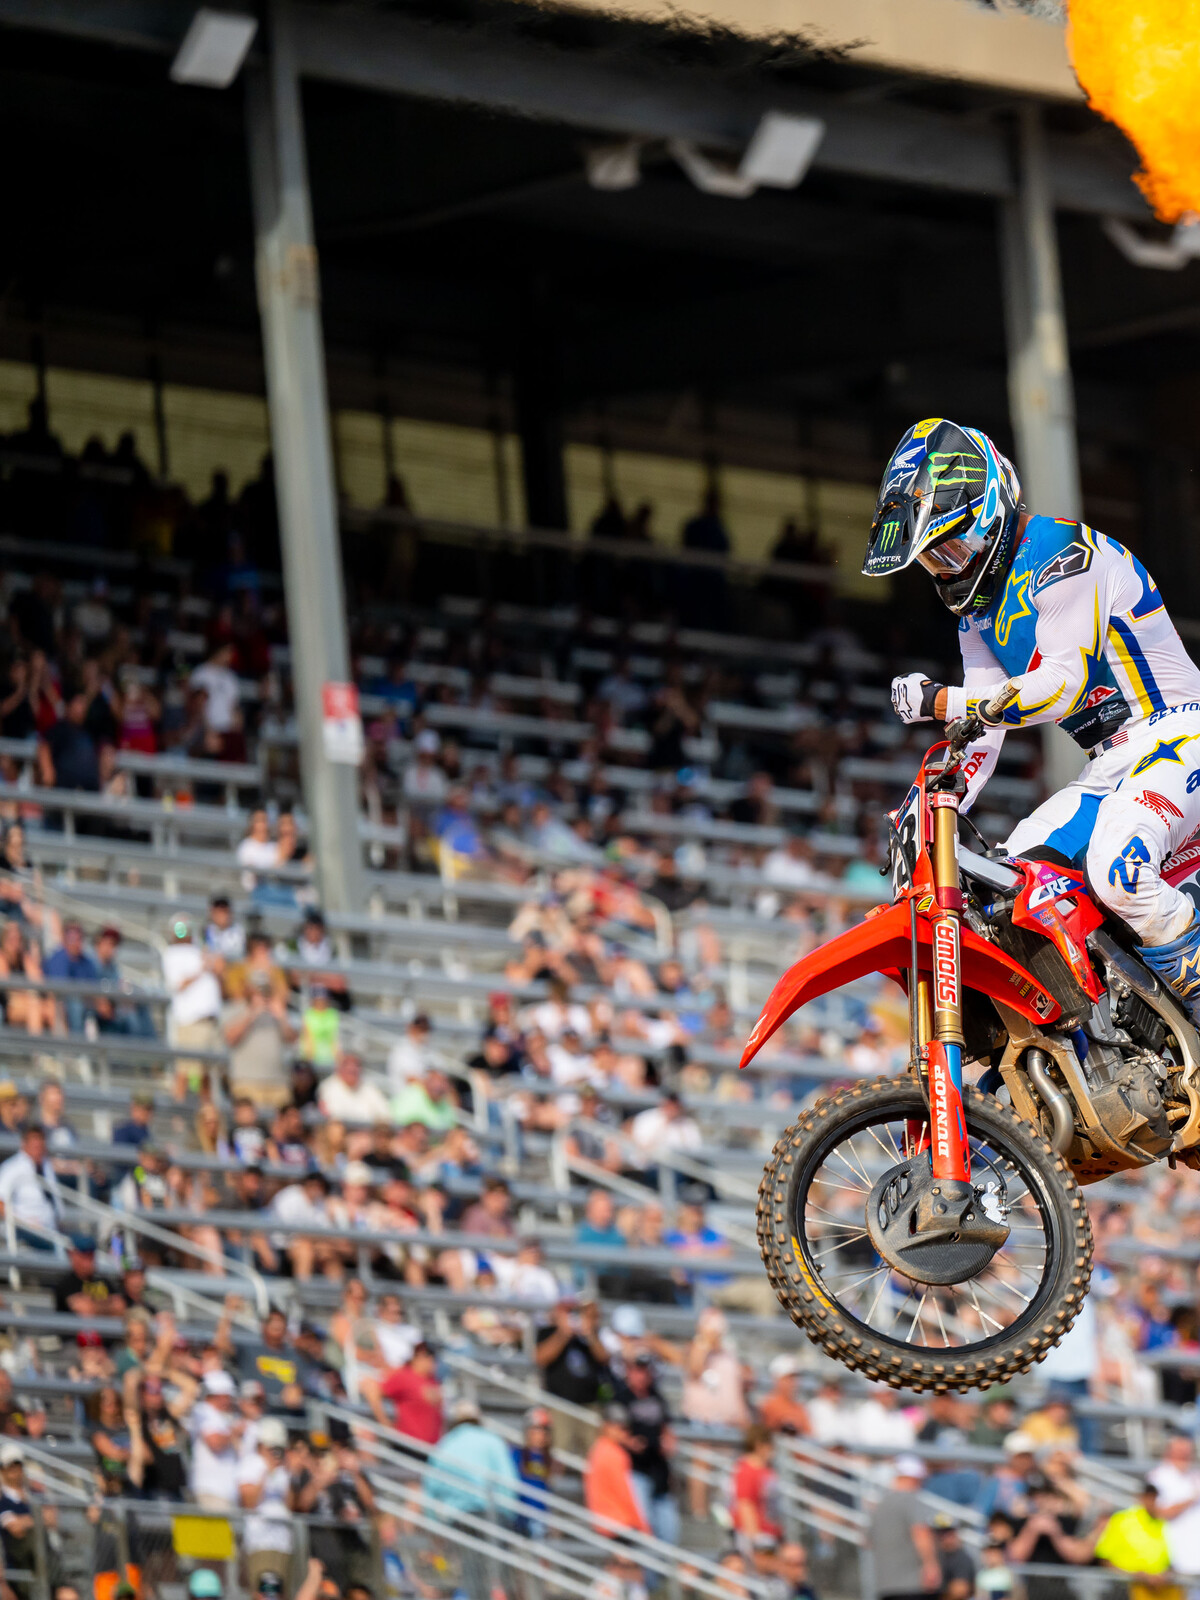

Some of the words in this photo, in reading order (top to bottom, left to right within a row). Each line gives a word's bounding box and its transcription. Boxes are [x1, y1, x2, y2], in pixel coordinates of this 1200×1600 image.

[891, 463, 916, 471] HONDA
[867, 555, 902, 566] MONSTER
[1133, 797, 1171, 832] HONDA
[1029, 875, 1071, 910] CRF
[936, 923, 958, 1008] SHOWA
[934, 1064, 949, 1158] DUNLOP
